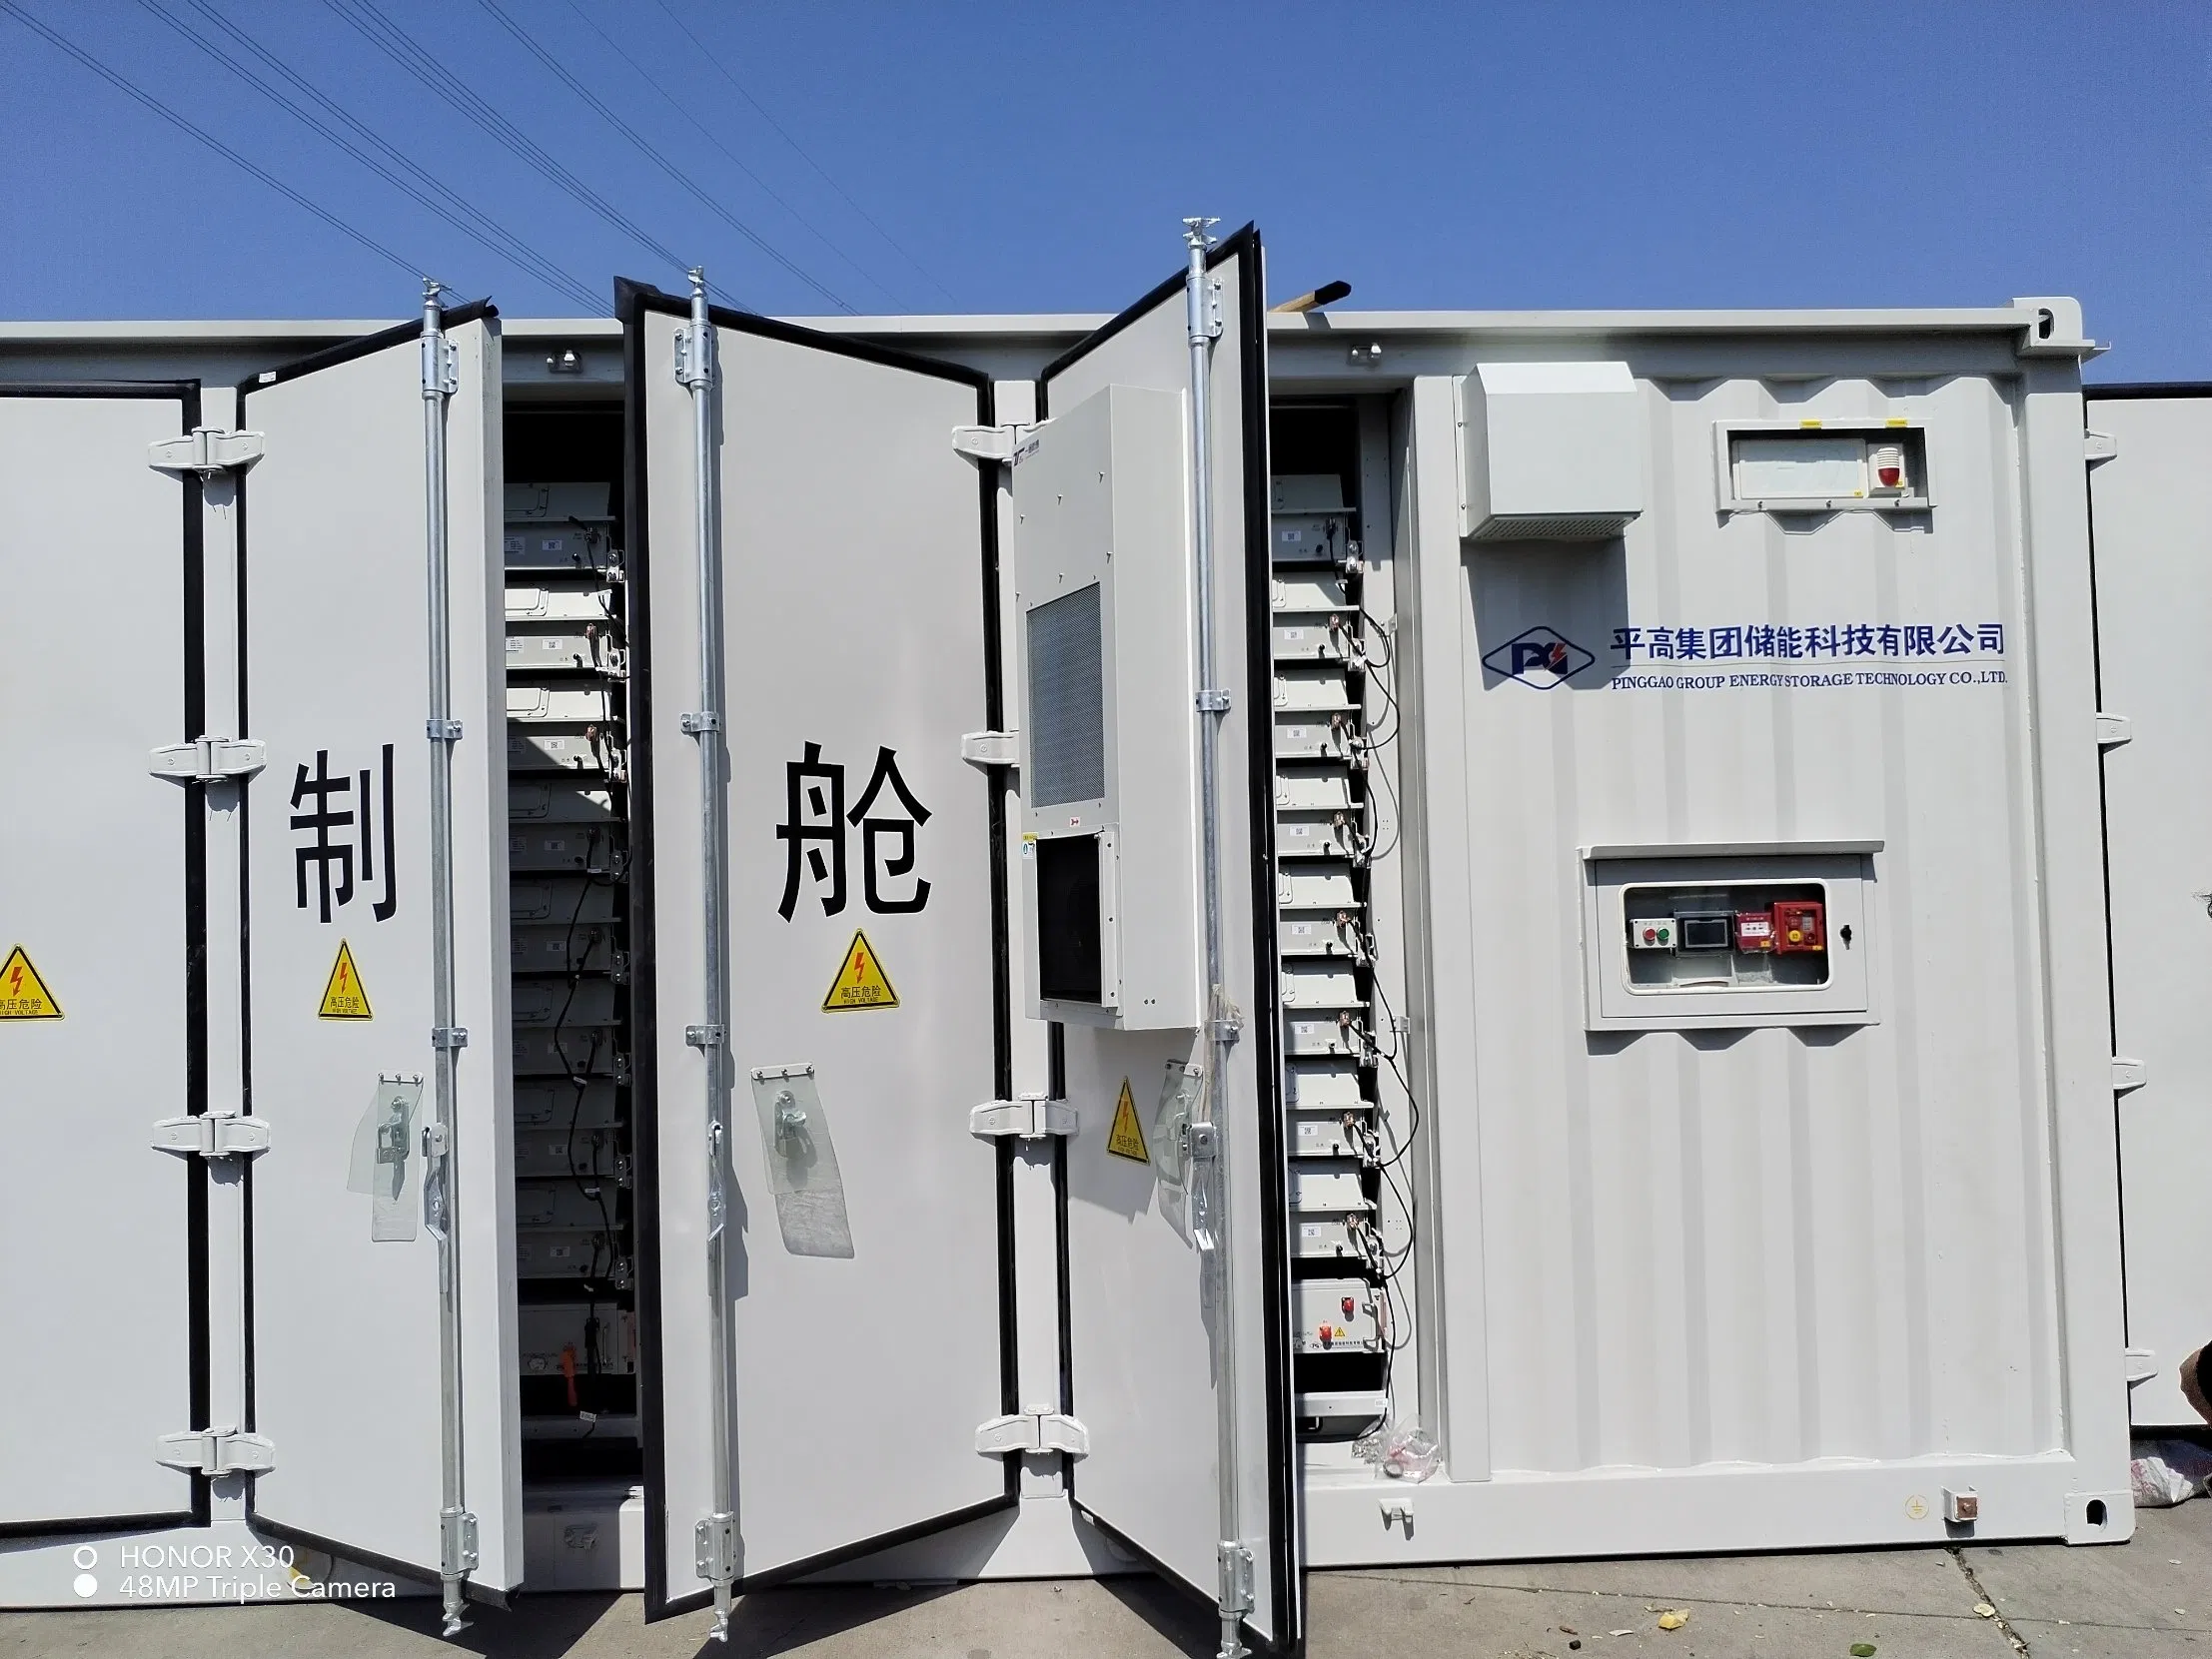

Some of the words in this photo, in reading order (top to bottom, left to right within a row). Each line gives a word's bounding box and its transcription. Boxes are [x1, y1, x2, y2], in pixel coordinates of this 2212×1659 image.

[1611, 623, 2004, 660] 平高集团储能科技有限公司
[1612, 675, 1674, 689] PINGGAO
[1676, 675, 1725, 689] GROUP
[1855, 672, 1946, 686] TECHNOLOGY
[288, 743, 397, 924] 制
[774, 741, 932, 923] 舱
[840, 985, 881, 999] 高压危险
